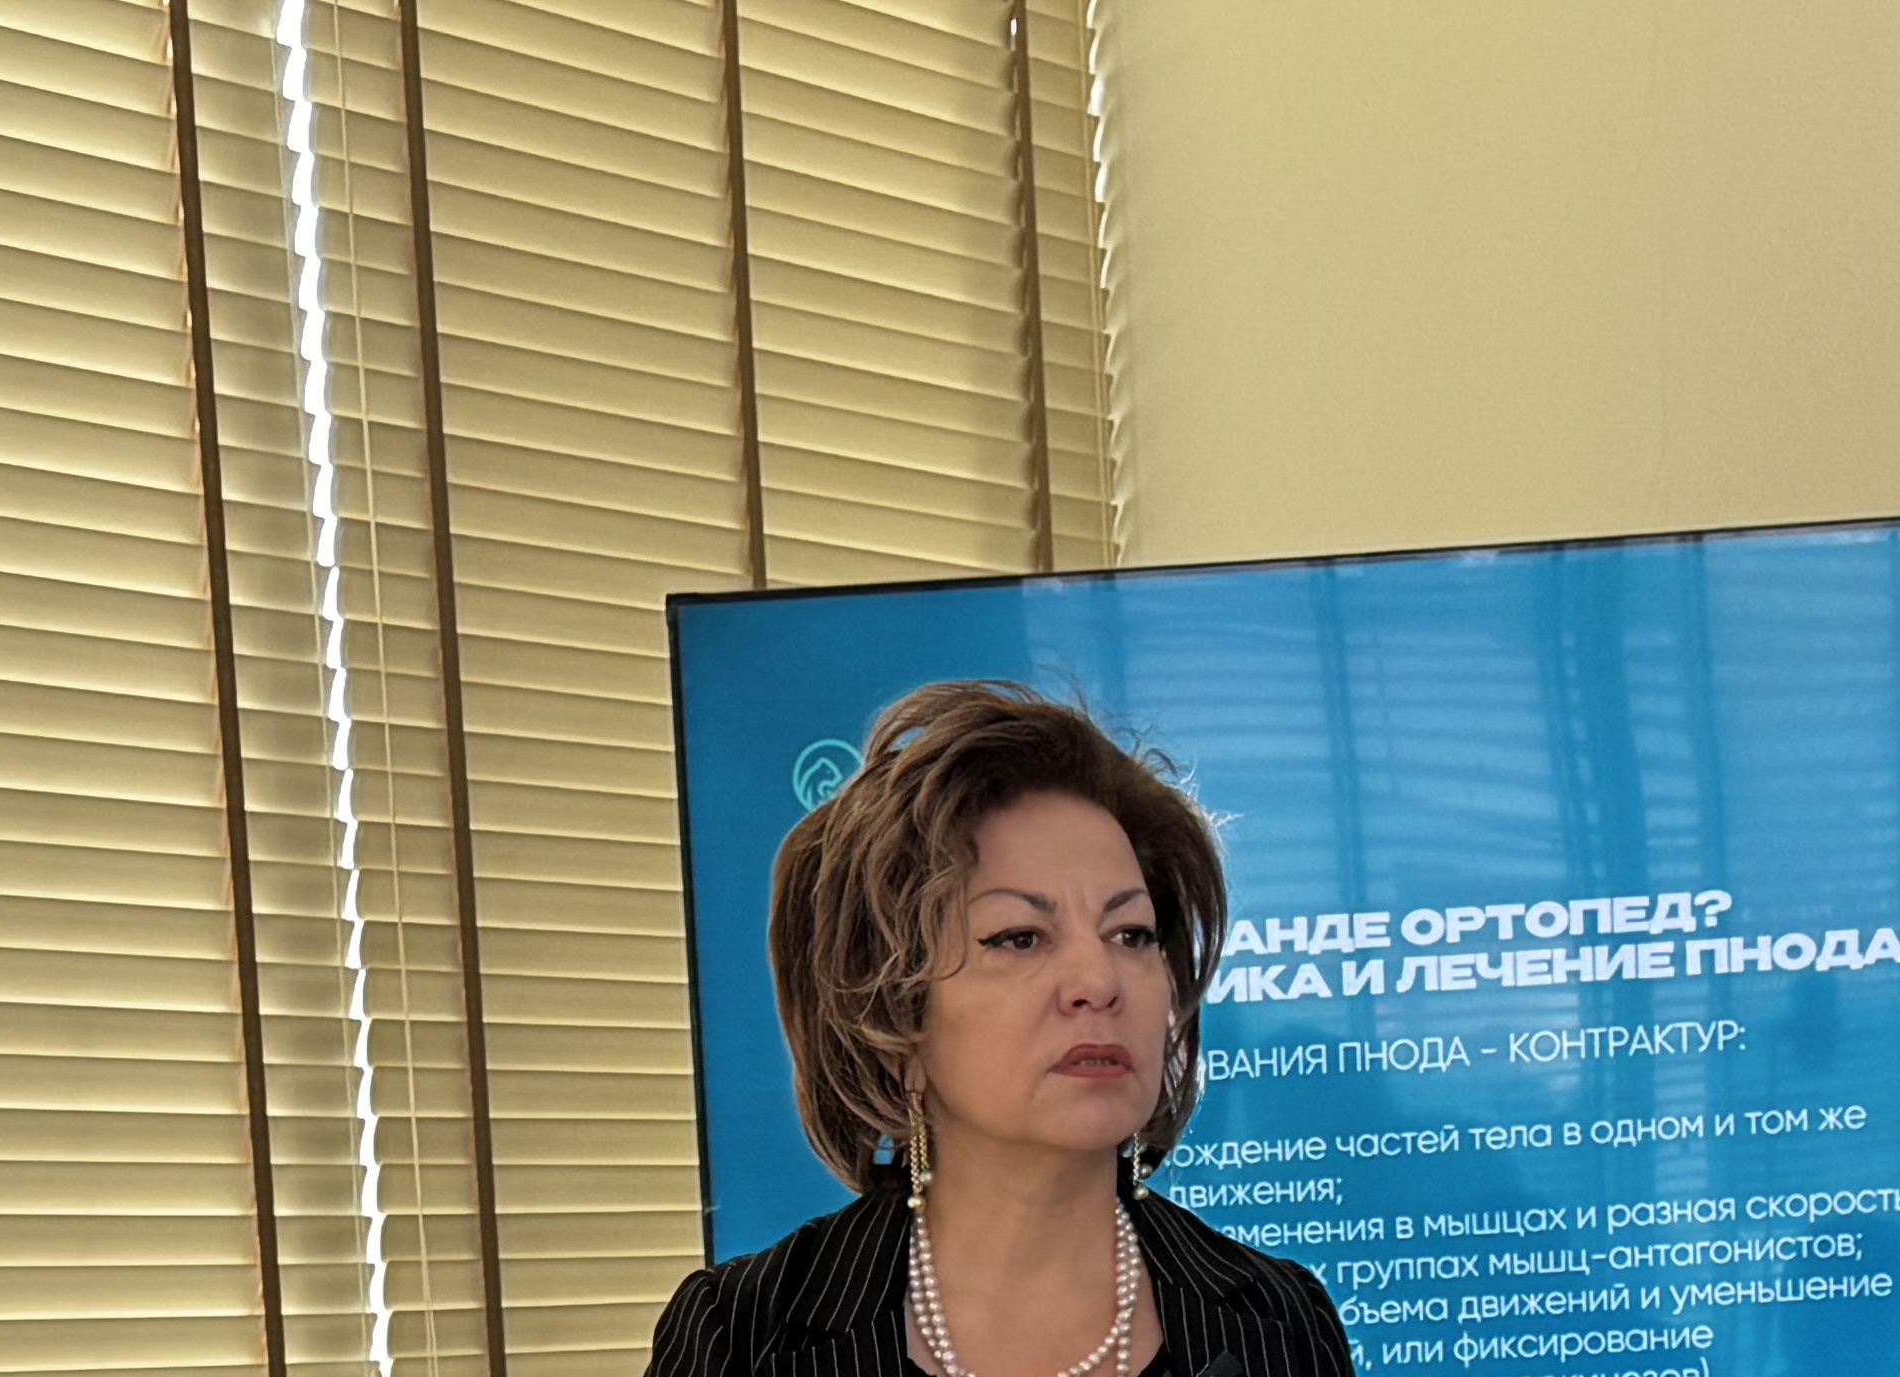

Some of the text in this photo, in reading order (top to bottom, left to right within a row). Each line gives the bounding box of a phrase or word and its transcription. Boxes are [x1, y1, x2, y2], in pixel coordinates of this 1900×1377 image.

[1227, 889, 1732, 957] АНДЕ ОРТОПЕД?
[1205, 963, 1333, 1005] ИКА
[1342, 959, 1385, 996] И
[1397, 942, 1675, 992] ЛЕЧЕНИЕ
[1201, 1043, 1327, 1082] ВАНИЯ
[1339, 1035, 1470, 1074] ПНОДА
[1509, 1021, 1747, 1064] КОНТРАКТУР:
[1165, 1103, 1868, 1171] ождение частей тела в одном и том же
[1396, 1216, 1413, 1239] в
[1423, 1205, 1566, 1243] мышцах
[1576, 1203, 1598, 1228] и
[1607, 1194, 1737, 1233] разная
[1337, 1252, 1480, 1291] группах
[1489, 1231, 1864, 1277] мышц-антагонистов;
[1341, 1271, 1893, 1328] бъема движений и уменьшение
[1383, 1338, 1444, 1367] или
[1453, 1321, 1714, 1366] фиксирование
